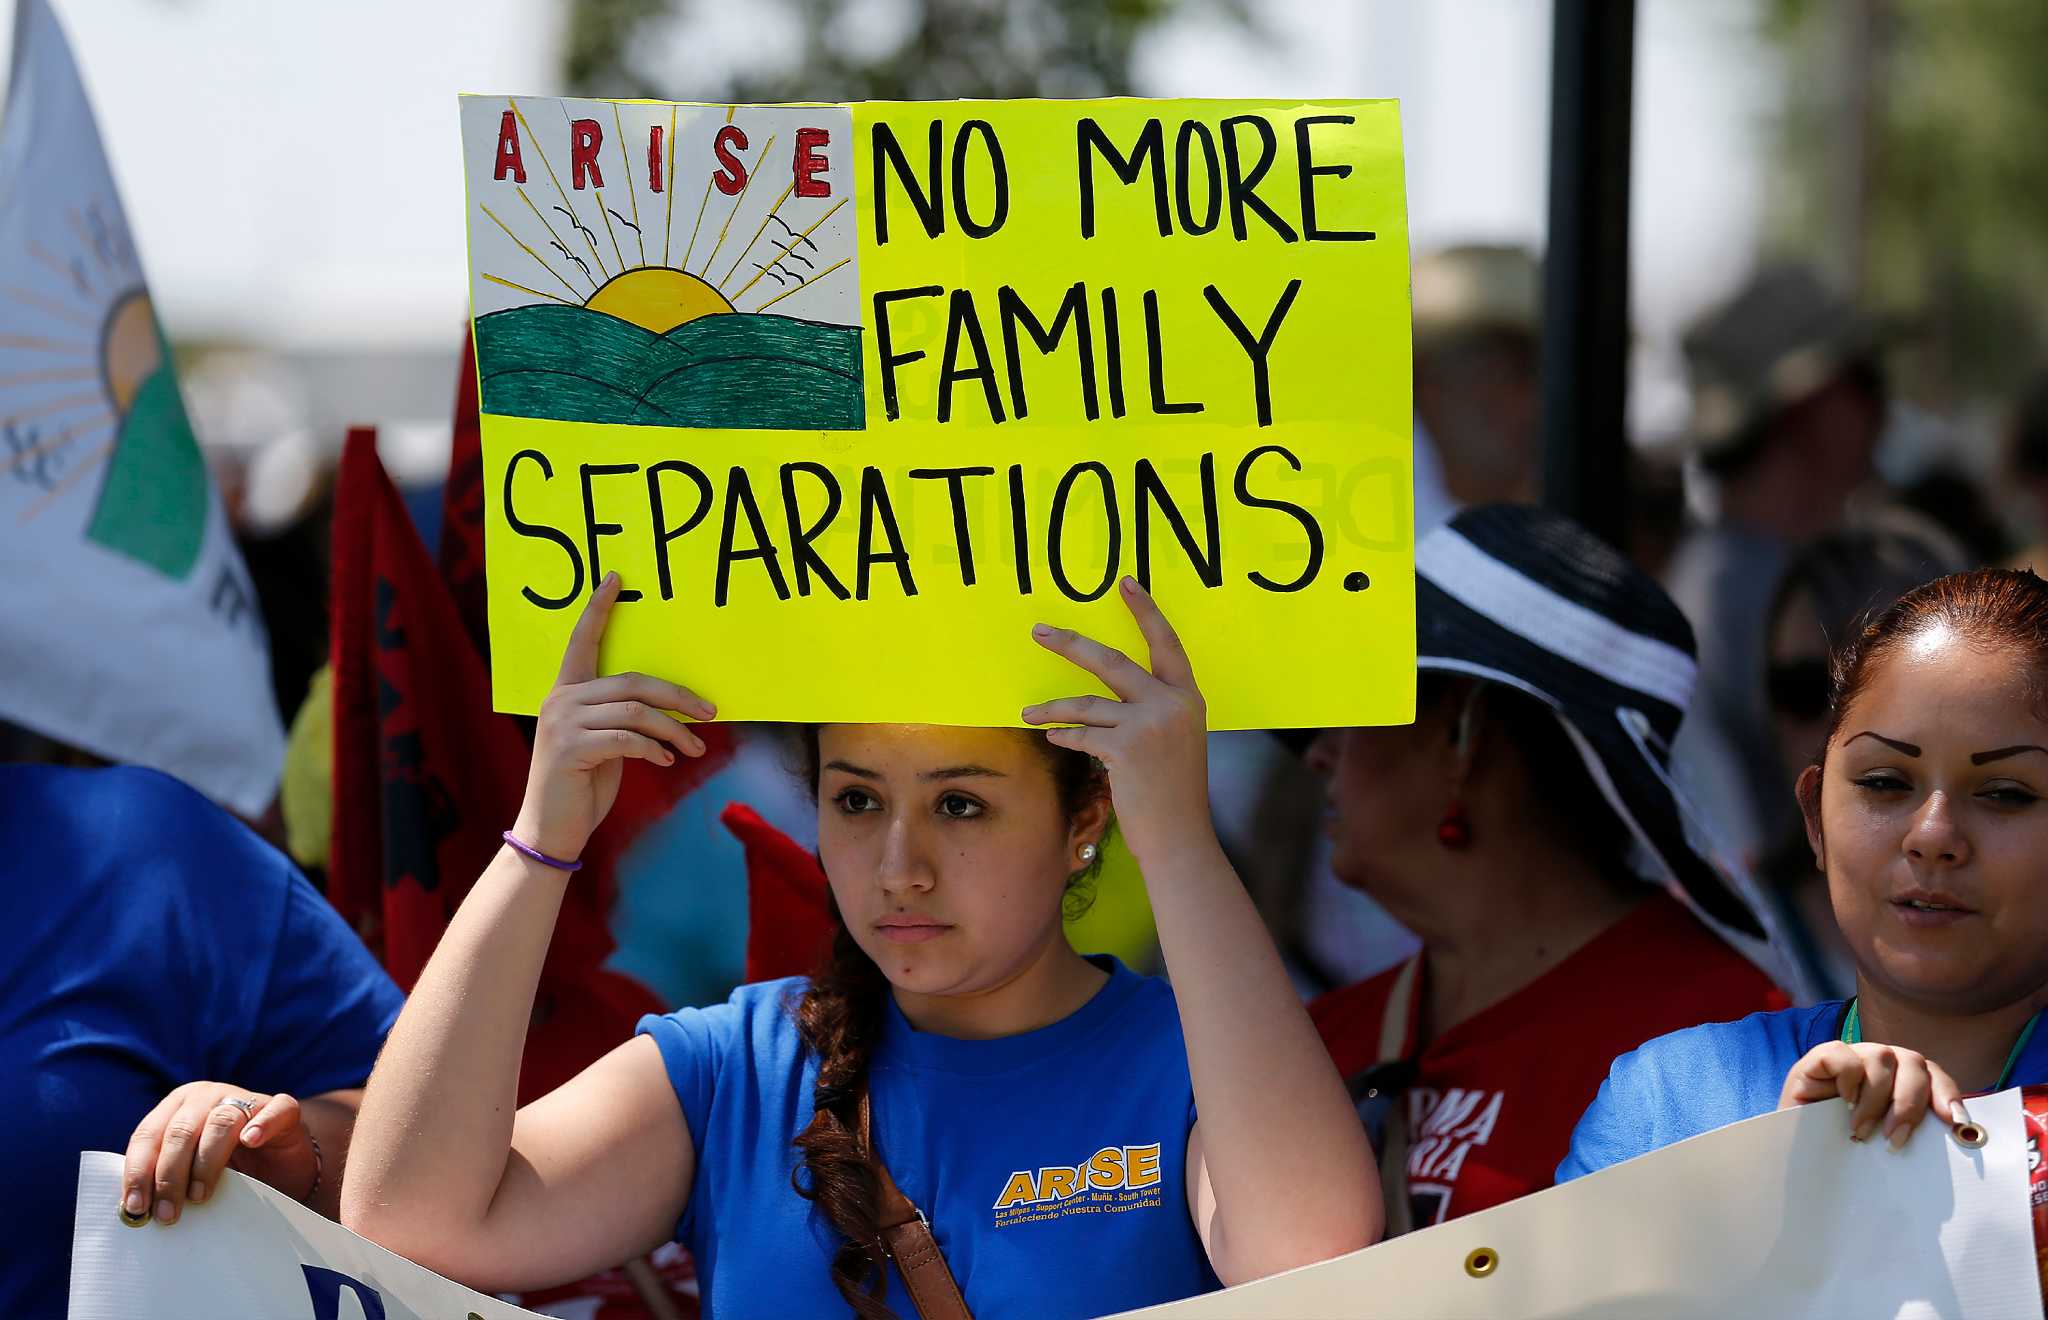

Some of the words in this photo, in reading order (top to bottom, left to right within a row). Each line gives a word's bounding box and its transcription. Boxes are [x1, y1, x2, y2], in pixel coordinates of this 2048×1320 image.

[494, 109, 831, 198] ARISE
[872, 119, 1009, 246] NO
[1076, 115, 1377, 245] MORE
[872, 279, 1302, 427] FAMILY
[503, 445, 1371, 610] SEPARATIONS.
[992, 1142, 1162, 1209] ARISE
[995, 1210, 1008, 1219] Las
[1036, 1202, 1062, 1213] Support
[1119, 1191, 1139, 1202] South
[1141, 1187, 1161, 1197] Tower
[1061, 1204, 1101, 1217] Nuestra
[1104, 1198, 1161, 1213] Comunidad
